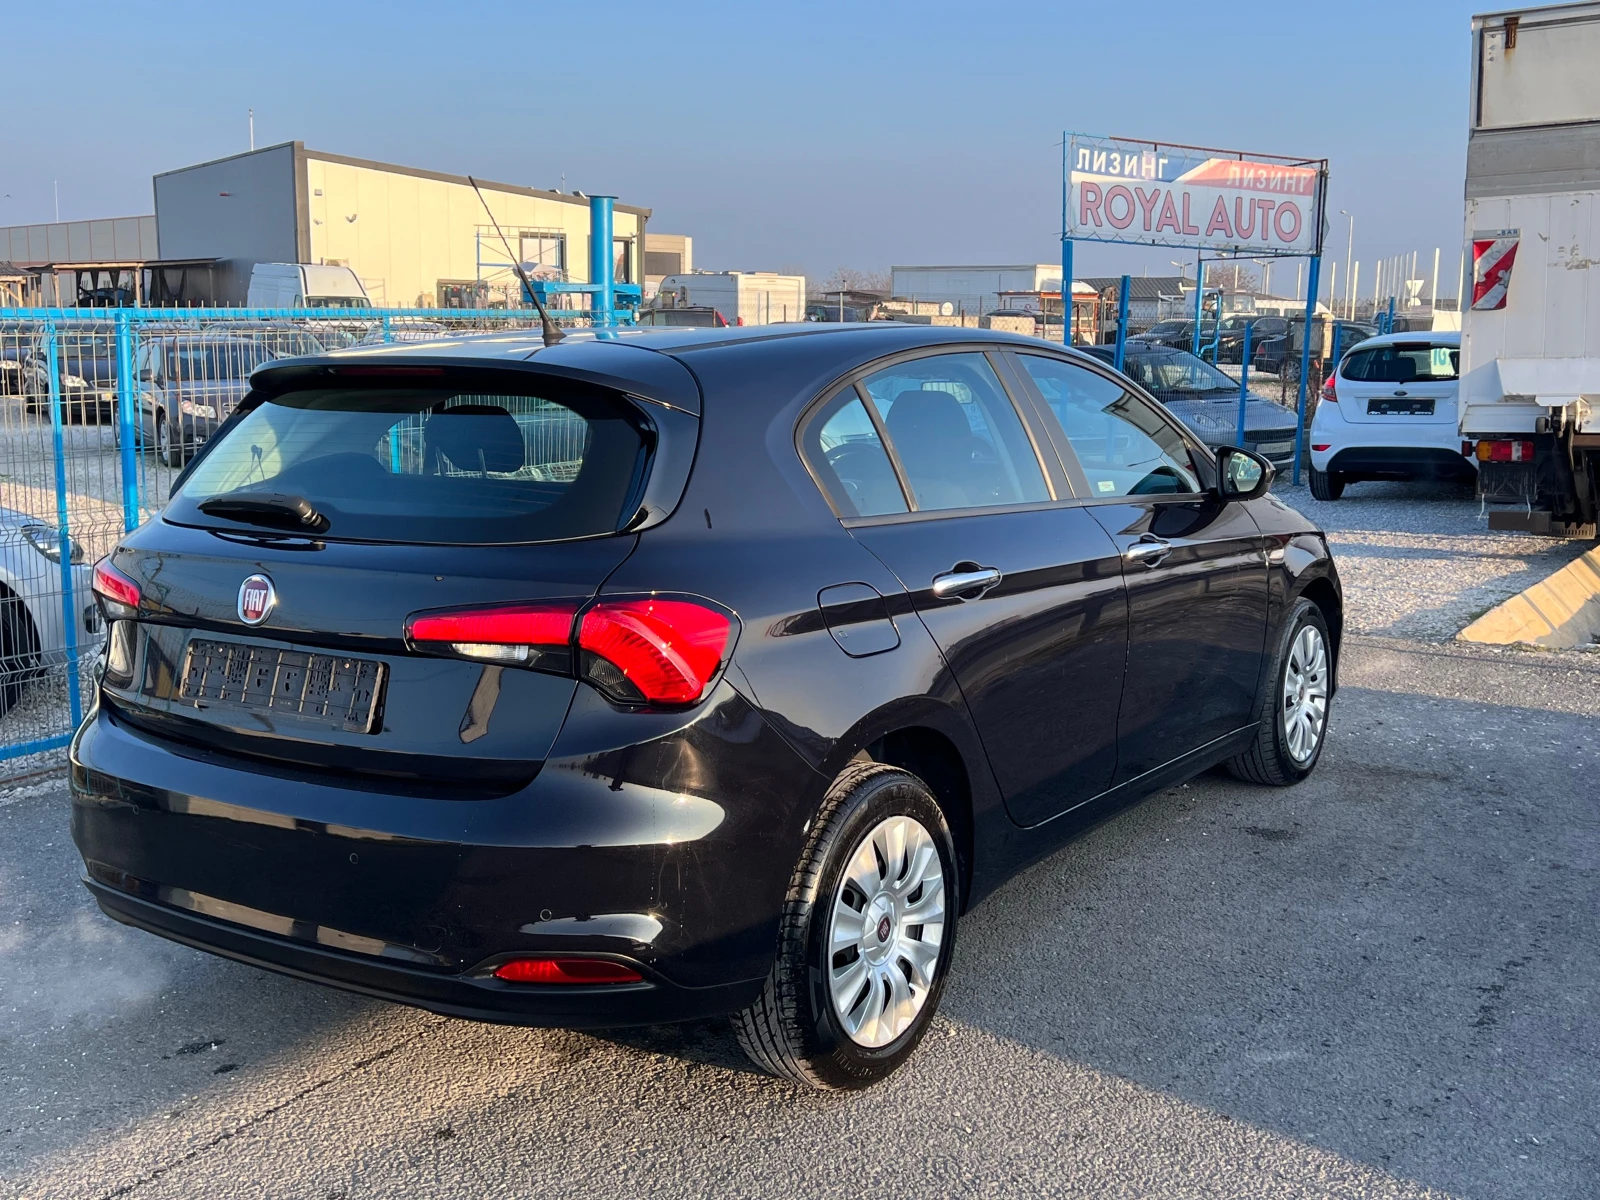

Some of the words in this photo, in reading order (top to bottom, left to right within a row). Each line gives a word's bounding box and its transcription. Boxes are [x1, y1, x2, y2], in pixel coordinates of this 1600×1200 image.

[1076, 148, 1168, 178] ЛИЗИНГ
[1227, 166, 1309, 192] ЛИЗИНГ
[1080, 181, 1199, 235] ROYAL
[1205, 195, 1302, 242] AUTO
[244, 588, 267, 611] FIAT
